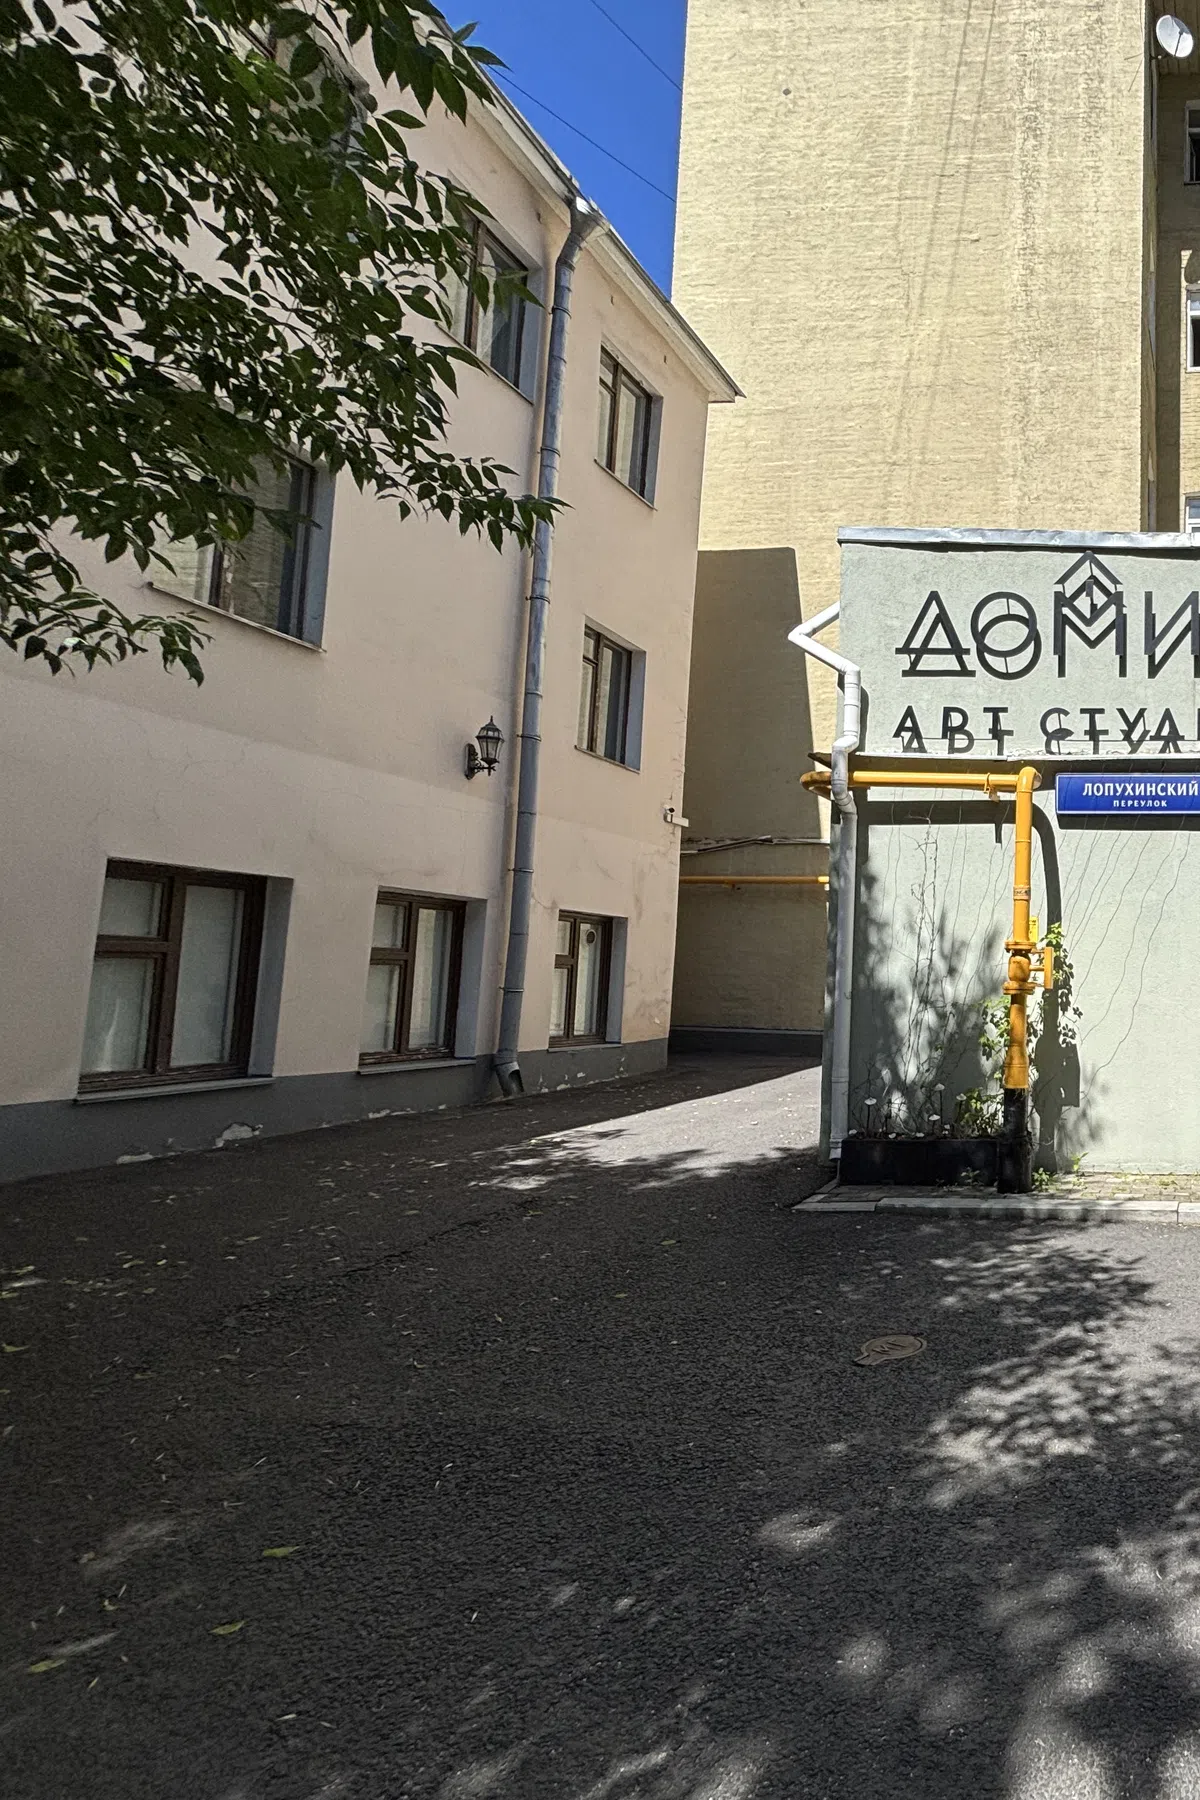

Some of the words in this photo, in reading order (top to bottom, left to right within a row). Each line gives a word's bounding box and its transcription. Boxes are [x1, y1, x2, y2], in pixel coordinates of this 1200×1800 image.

[893, 705, 1009, 740] АРТ
[1083, 780, 1199, 796] ЛОПУХИНСКИЙ
[1113, 799, 1168, 807] ПЕРЕУЛОК
